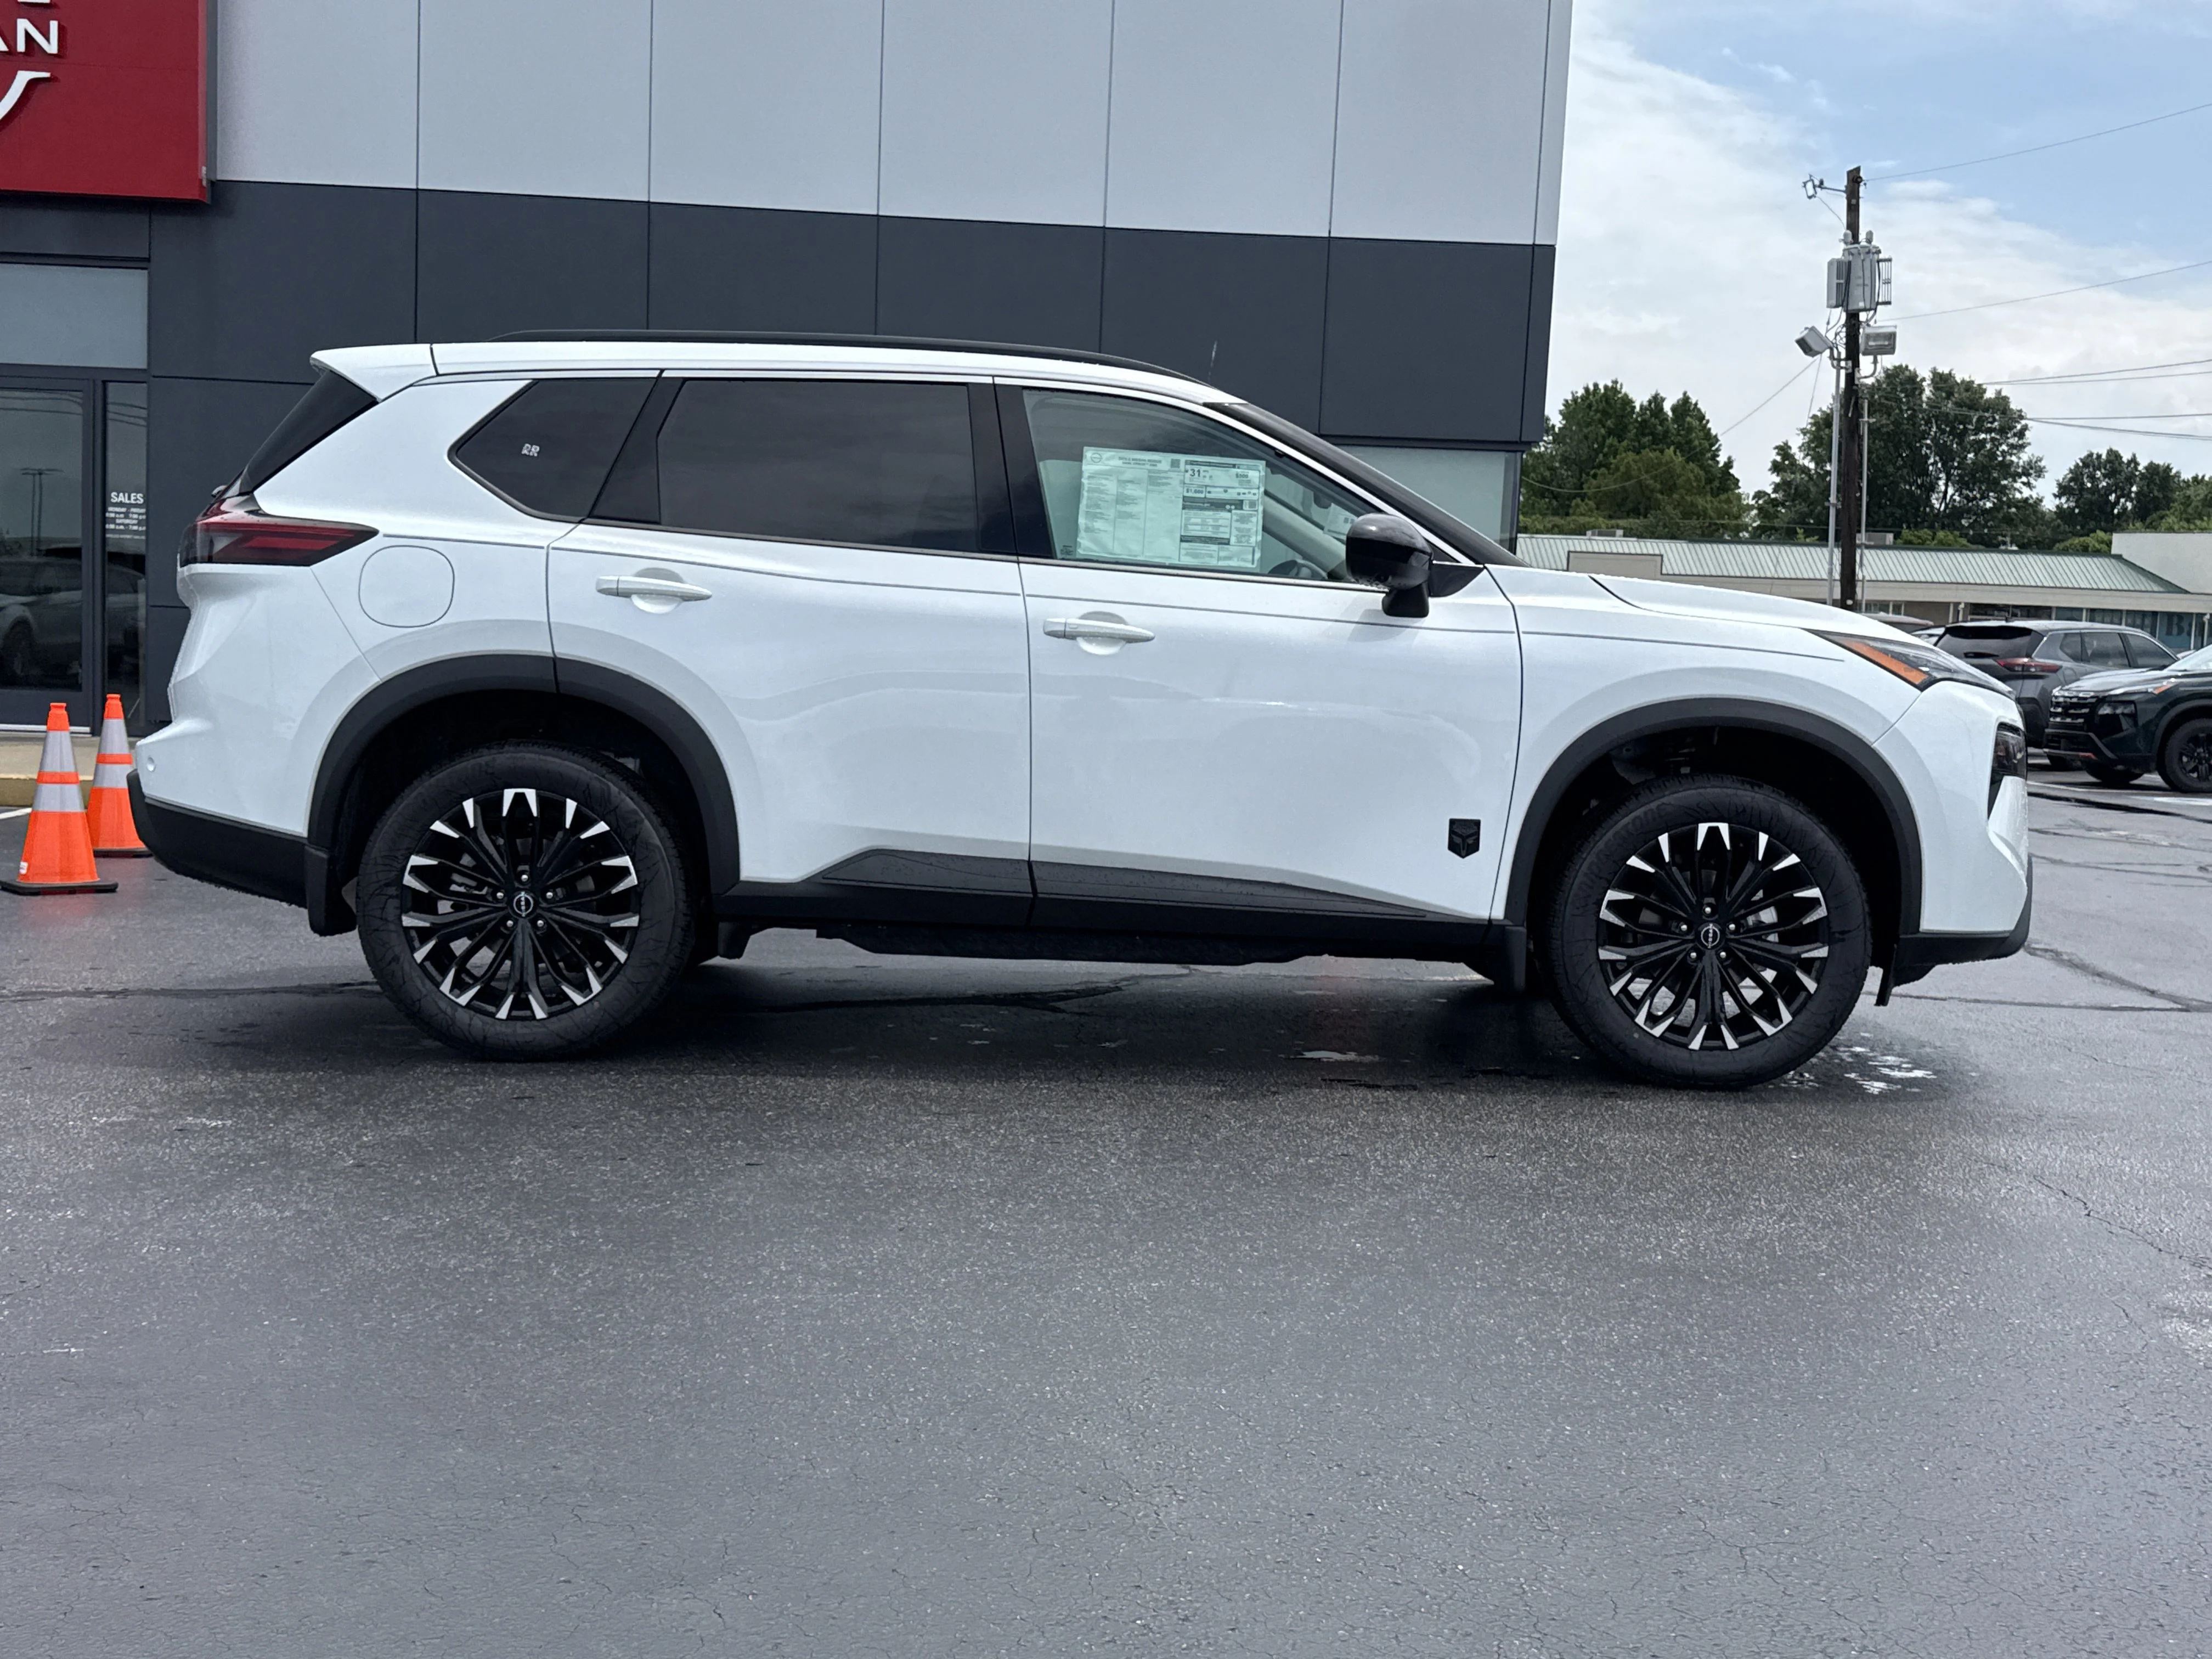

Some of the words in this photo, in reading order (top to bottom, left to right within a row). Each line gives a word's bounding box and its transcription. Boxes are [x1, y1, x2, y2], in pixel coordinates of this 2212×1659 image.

[0, 18, 58, 54] N
[1189, 469, 1200, 477] 31
[110, 492, 144, 504] SALES
